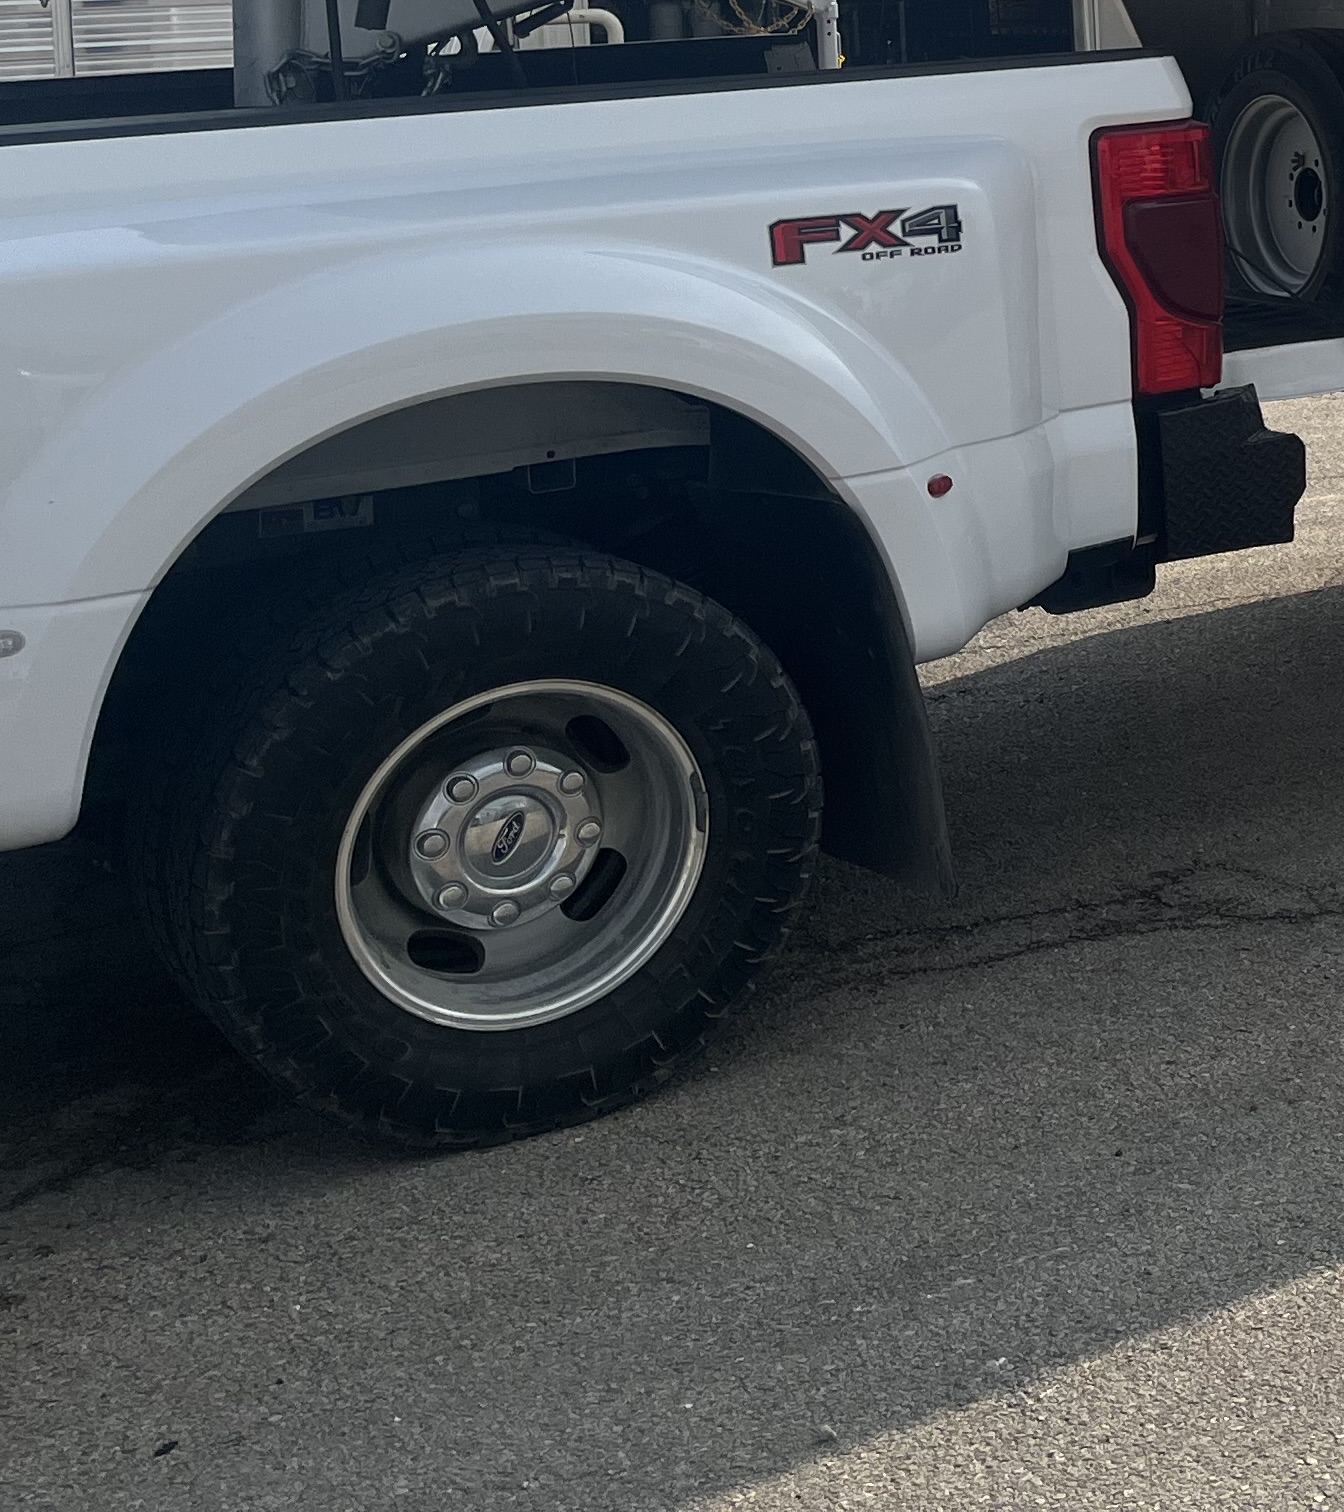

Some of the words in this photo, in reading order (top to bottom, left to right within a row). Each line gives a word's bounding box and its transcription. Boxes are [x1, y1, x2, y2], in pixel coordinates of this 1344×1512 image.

[768, 204, 963, 268] FX4
[861, 249, 903, 262] OFF
[909, 243, 963, 258] ROAD
[495, 819, 521, 855] Ford
